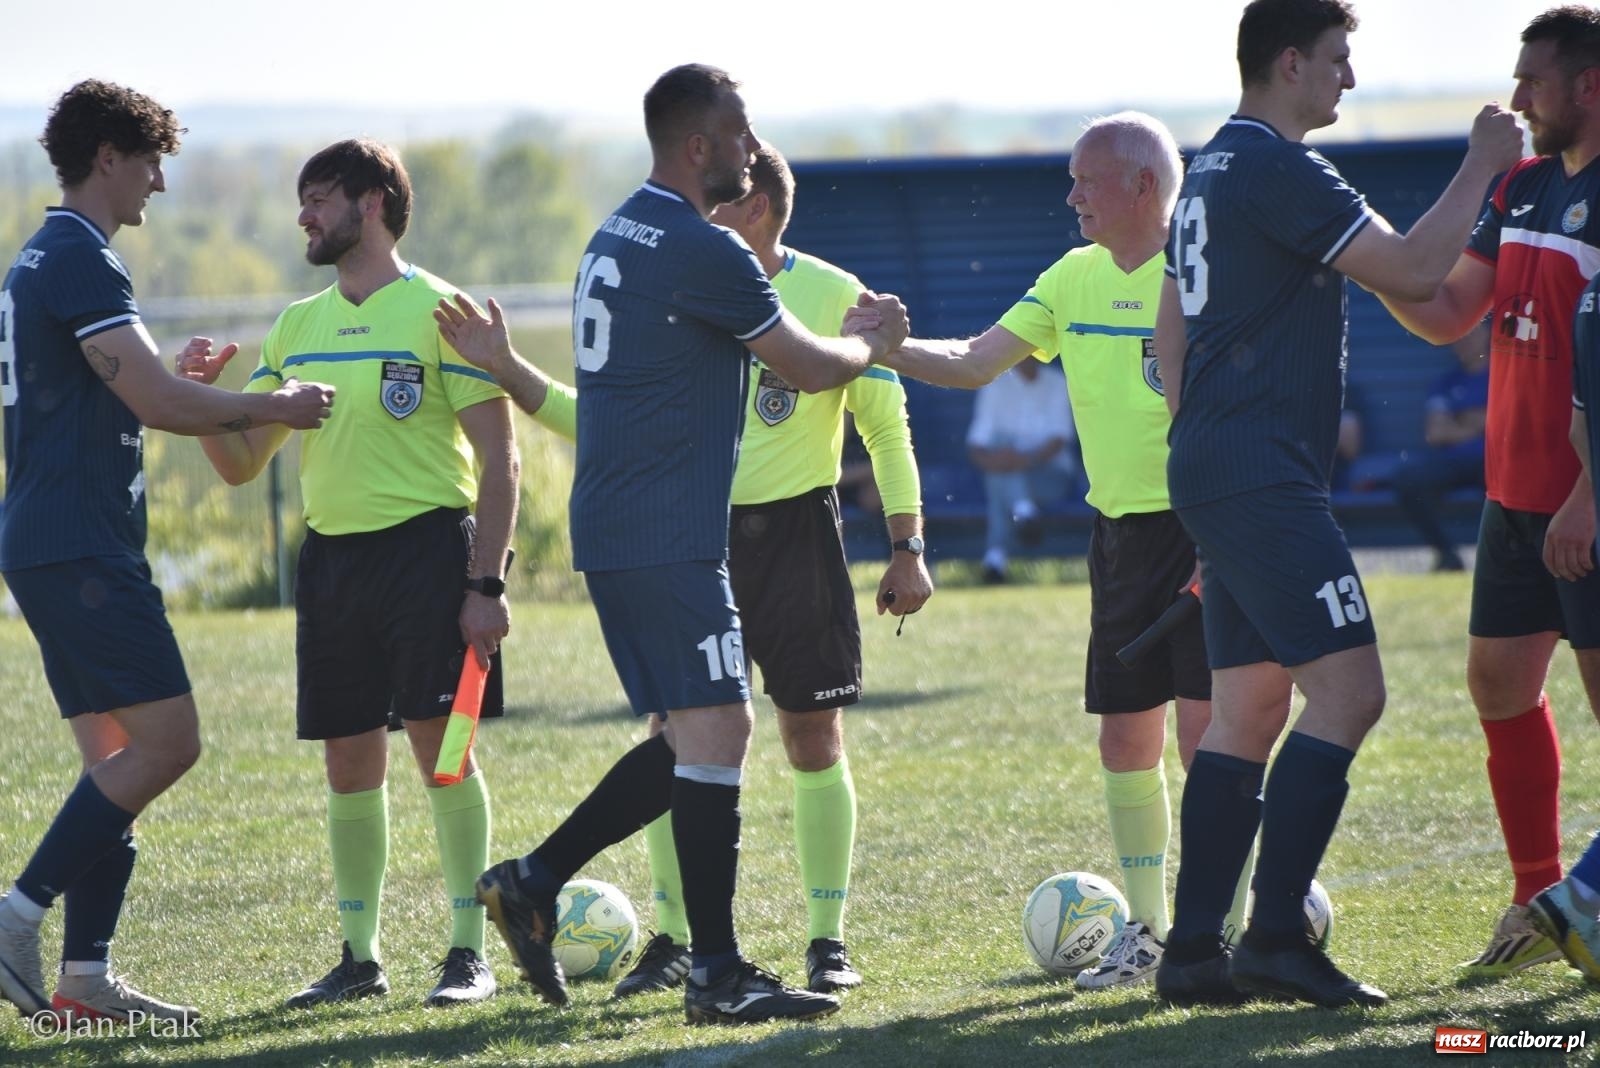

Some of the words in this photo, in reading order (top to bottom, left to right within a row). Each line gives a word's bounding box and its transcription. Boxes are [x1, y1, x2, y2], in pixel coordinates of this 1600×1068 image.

[1173, 196, 1209, 316] 13
[1315, 574, 1367, 629] 13
[697, 630, 746, 681] 16
